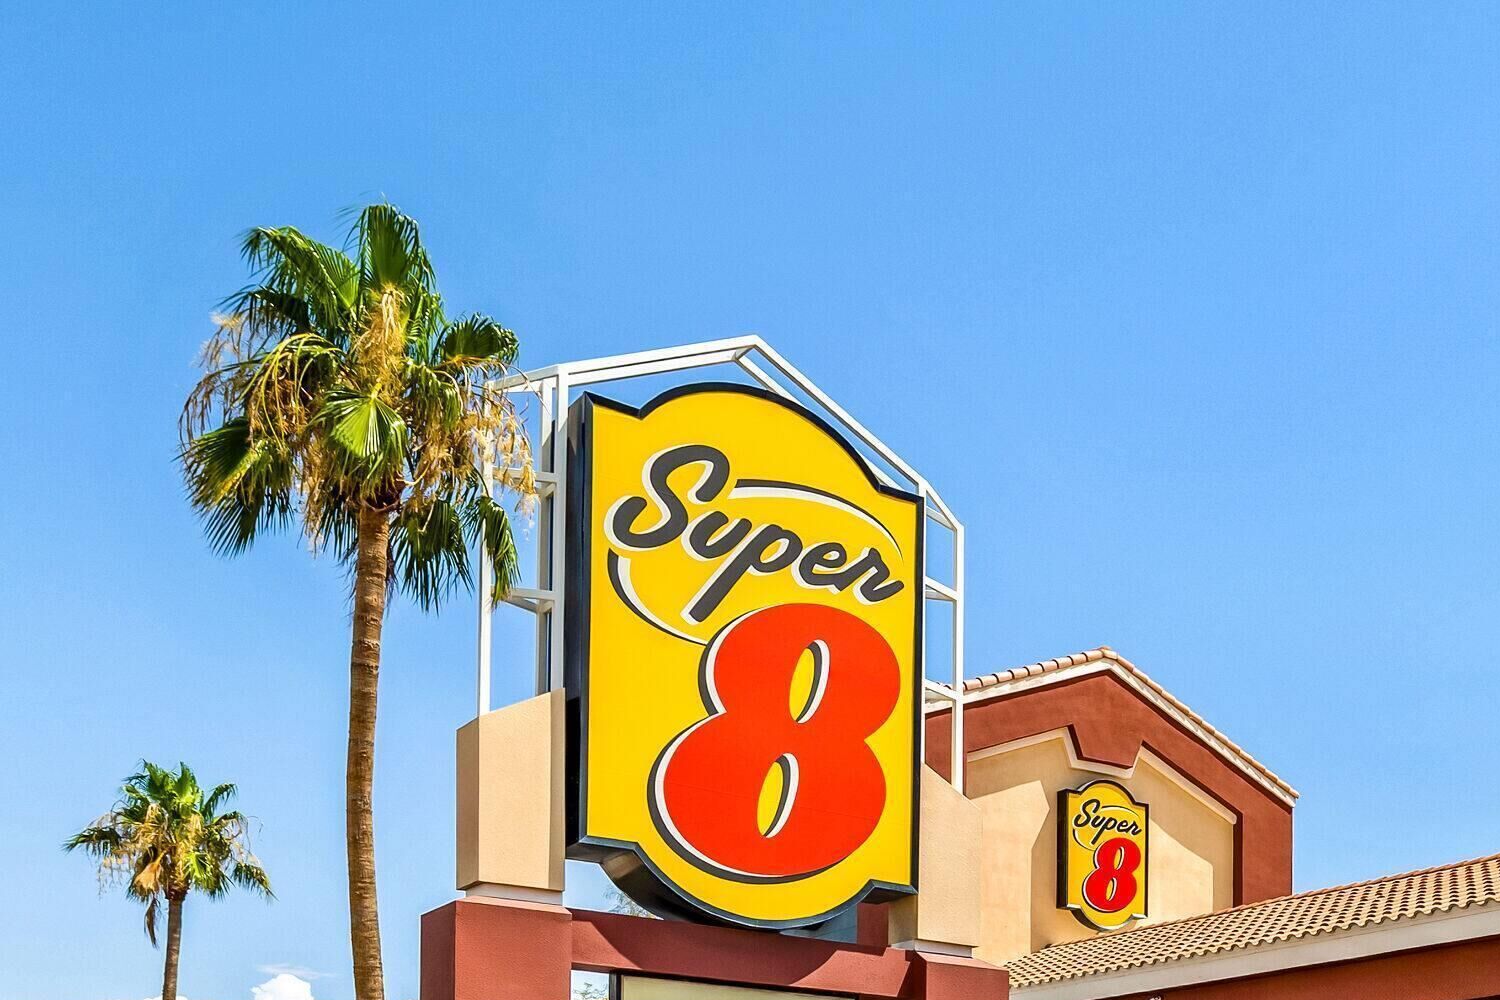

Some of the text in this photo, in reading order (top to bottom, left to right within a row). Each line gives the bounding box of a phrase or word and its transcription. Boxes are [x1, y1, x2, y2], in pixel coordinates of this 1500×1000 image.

[609, 444, 904, 623] Super
[648, 602, 901, 883] 8
[1073, 798, 1142, 845] Super
[1082, 837, 1142, 913] 8
